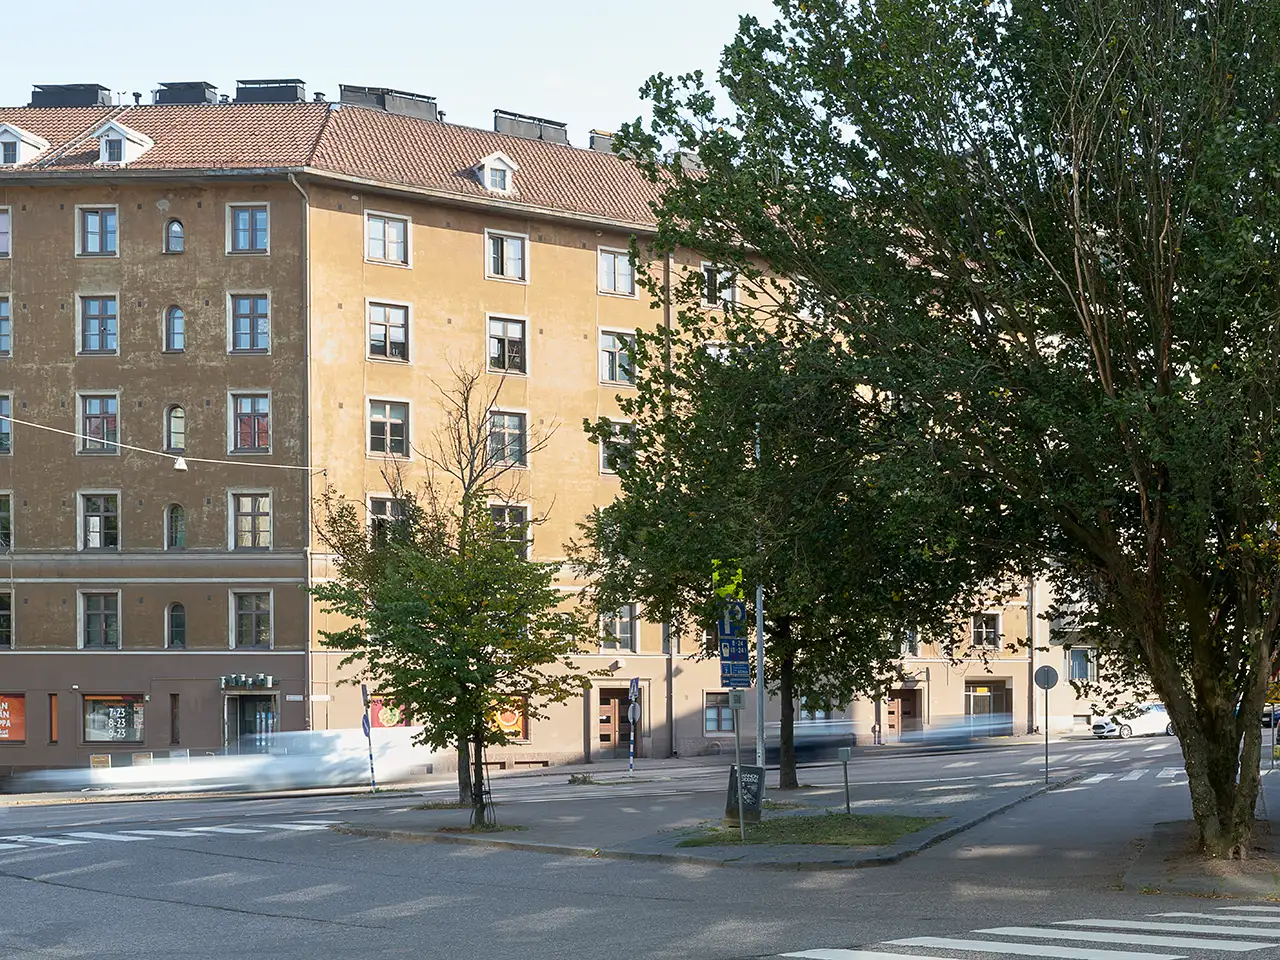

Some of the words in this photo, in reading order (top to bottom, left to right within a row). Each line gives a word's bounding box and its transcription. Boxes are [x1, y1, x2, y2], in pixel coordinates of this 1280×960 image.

[109, 708, 126, 717] 7-23
[108, 719, 126, 727] 8-23
[108, 729, 126, 738] 9-23
